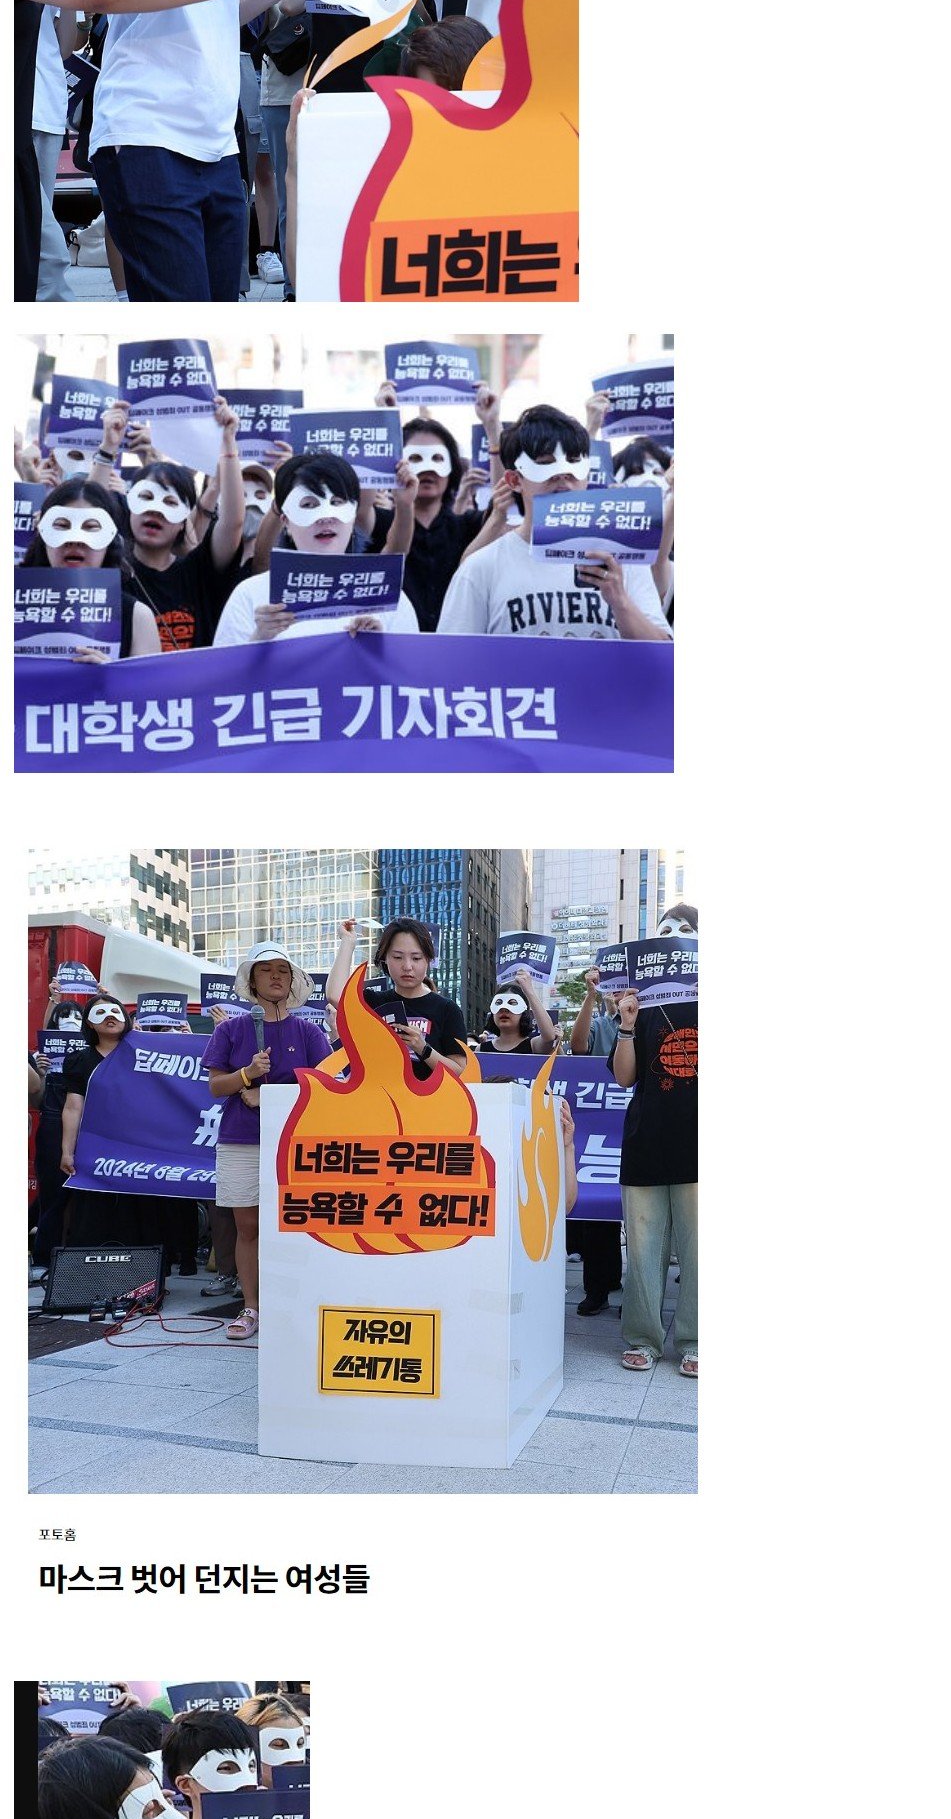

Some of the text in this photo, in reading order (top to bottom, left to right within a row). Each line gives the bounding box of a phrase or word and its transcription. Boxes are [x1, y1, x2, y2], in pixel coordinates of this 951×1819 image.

[380, 227, 562, 298] 너희는
[306, 427, 388, 443] 너희는 우리를
[550, 500, 646, 513] 너희는 우리를
[287, 571, 385, 588] 너희는 우리를
[15, 588, 108, 604] 너희는 우리를
[282, 585, 390, 604] 능욕할 수 없다!
[25, 683, 559, 754] 대학생 긴급 기자회견
[637, 952, 668, 967] 너희는
[635, 966, 664, 980] 능욕할
[294, 1141, 475, 1176] 너희는 우리를
[93, 1157, 188, 1181] 2024년 8월
[283, 1191, 489, 1228] 능욕할 수 없다!
[85, 1255, 131, 1263] CUBE
[343, 1319, 412, 1345] 자유의
[332, 1355, 423, 1383] 쓰레기통
